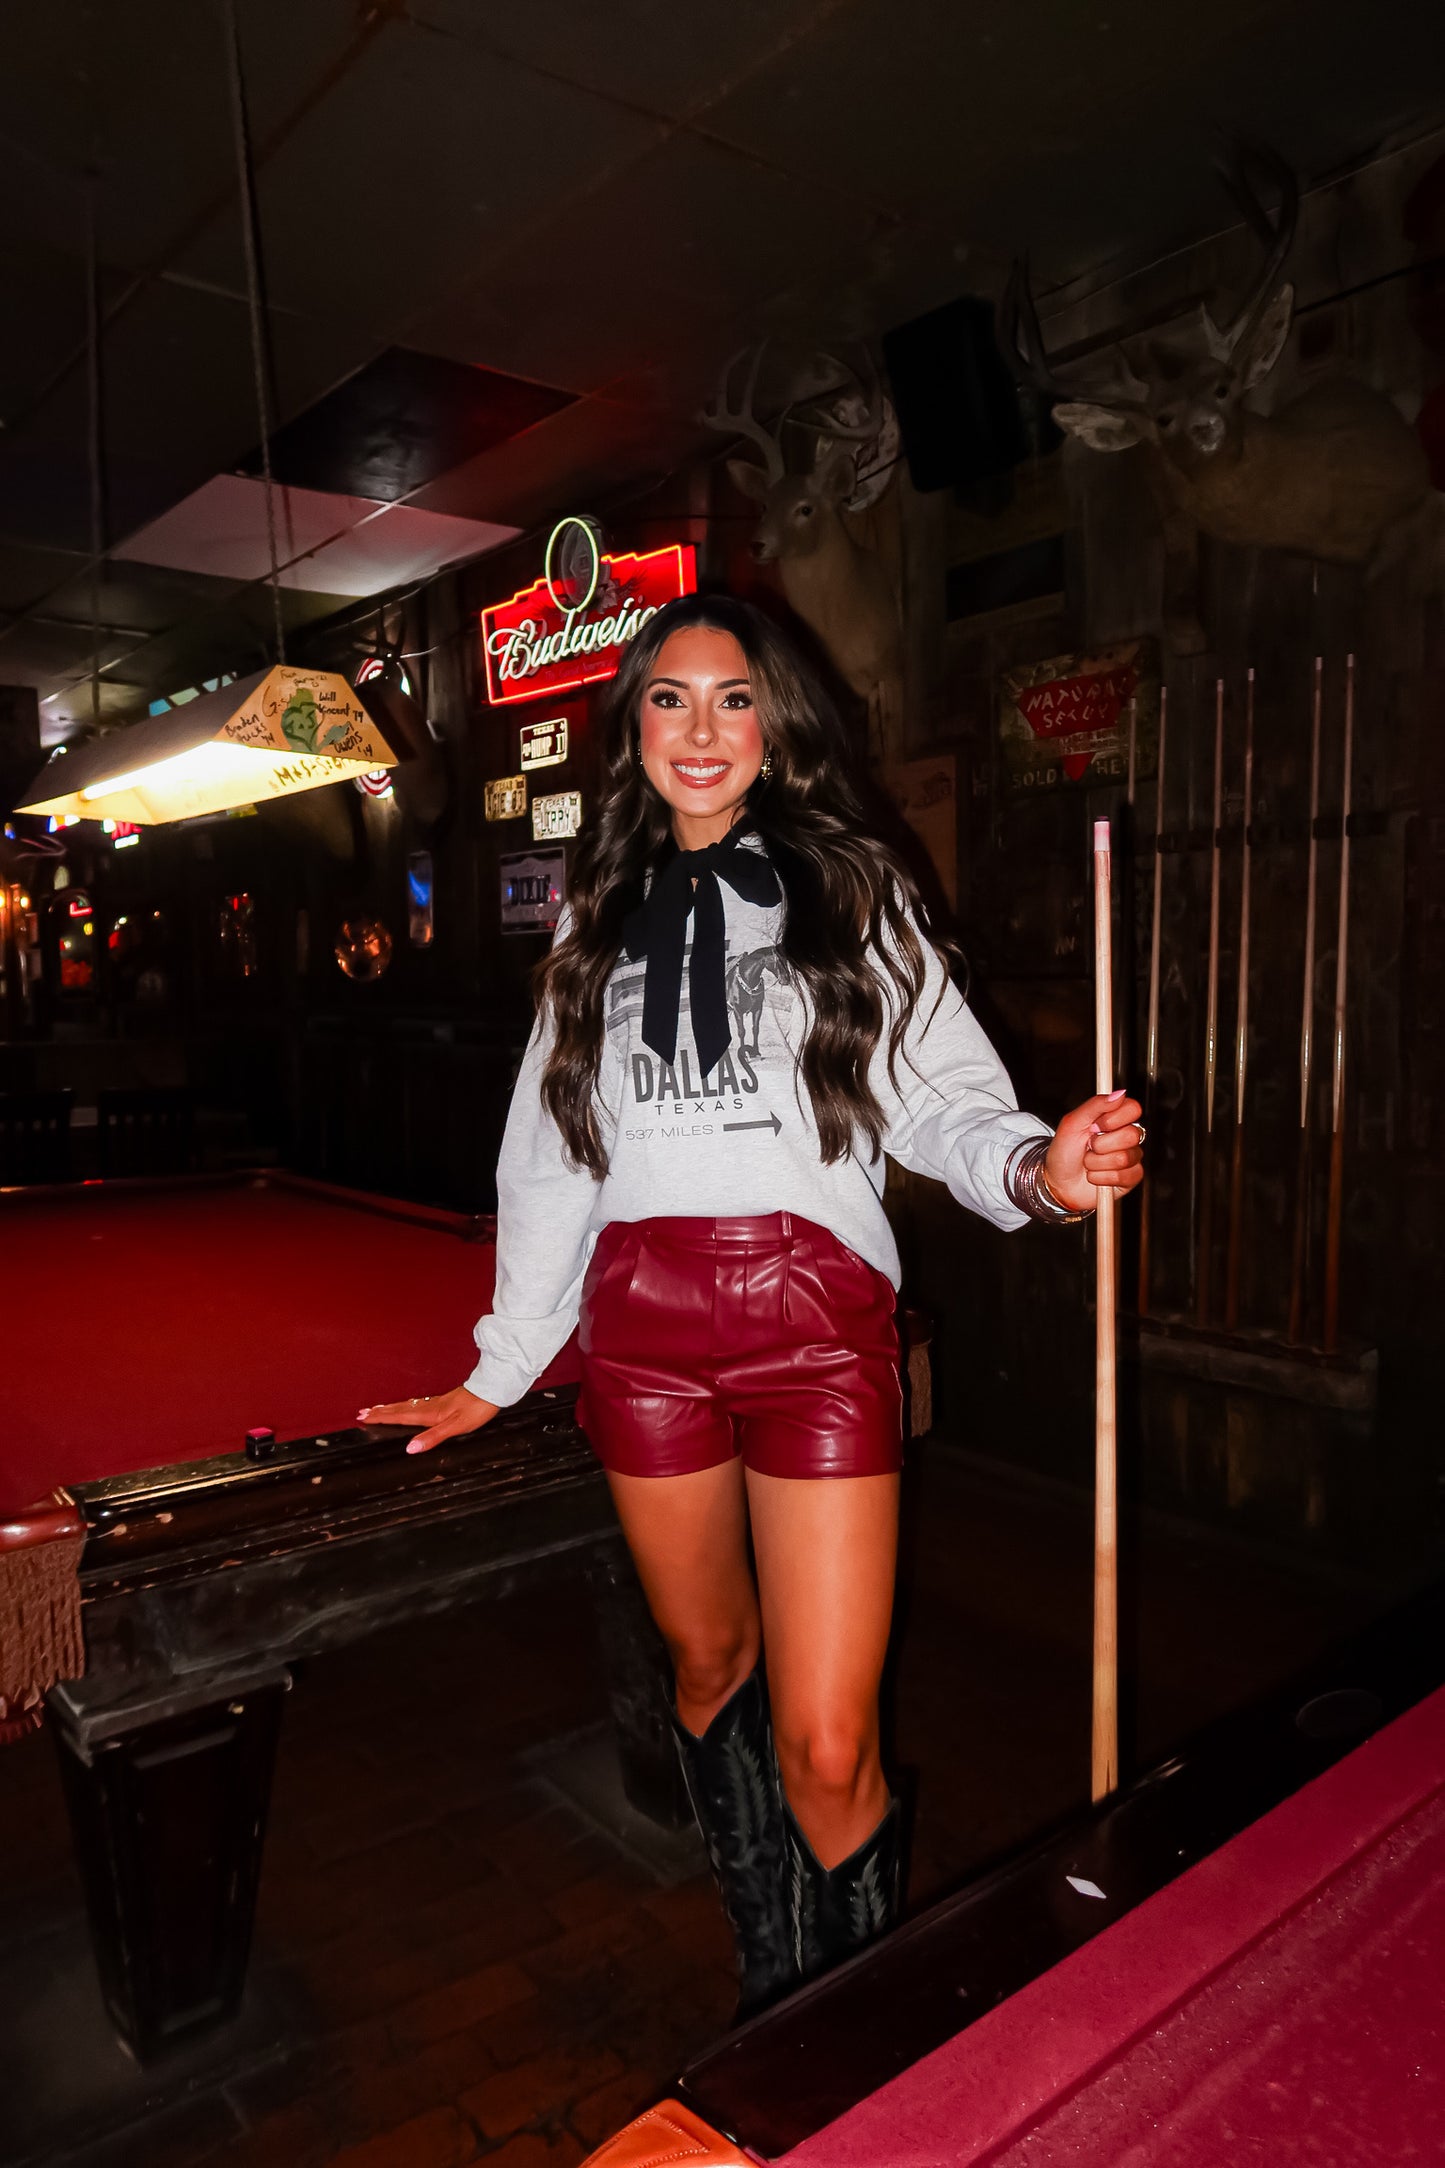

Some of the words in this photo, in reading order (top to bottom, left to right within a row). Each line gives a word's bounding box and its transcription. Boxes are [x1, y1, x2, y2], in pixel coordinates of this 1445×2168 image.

[487, 597, 667, 681] Budweise
[655, 1098, 743, 1115] TEXAS
[626, 1128, 654, 1141] 537
[661, 1124, 714, 1138] MILES
